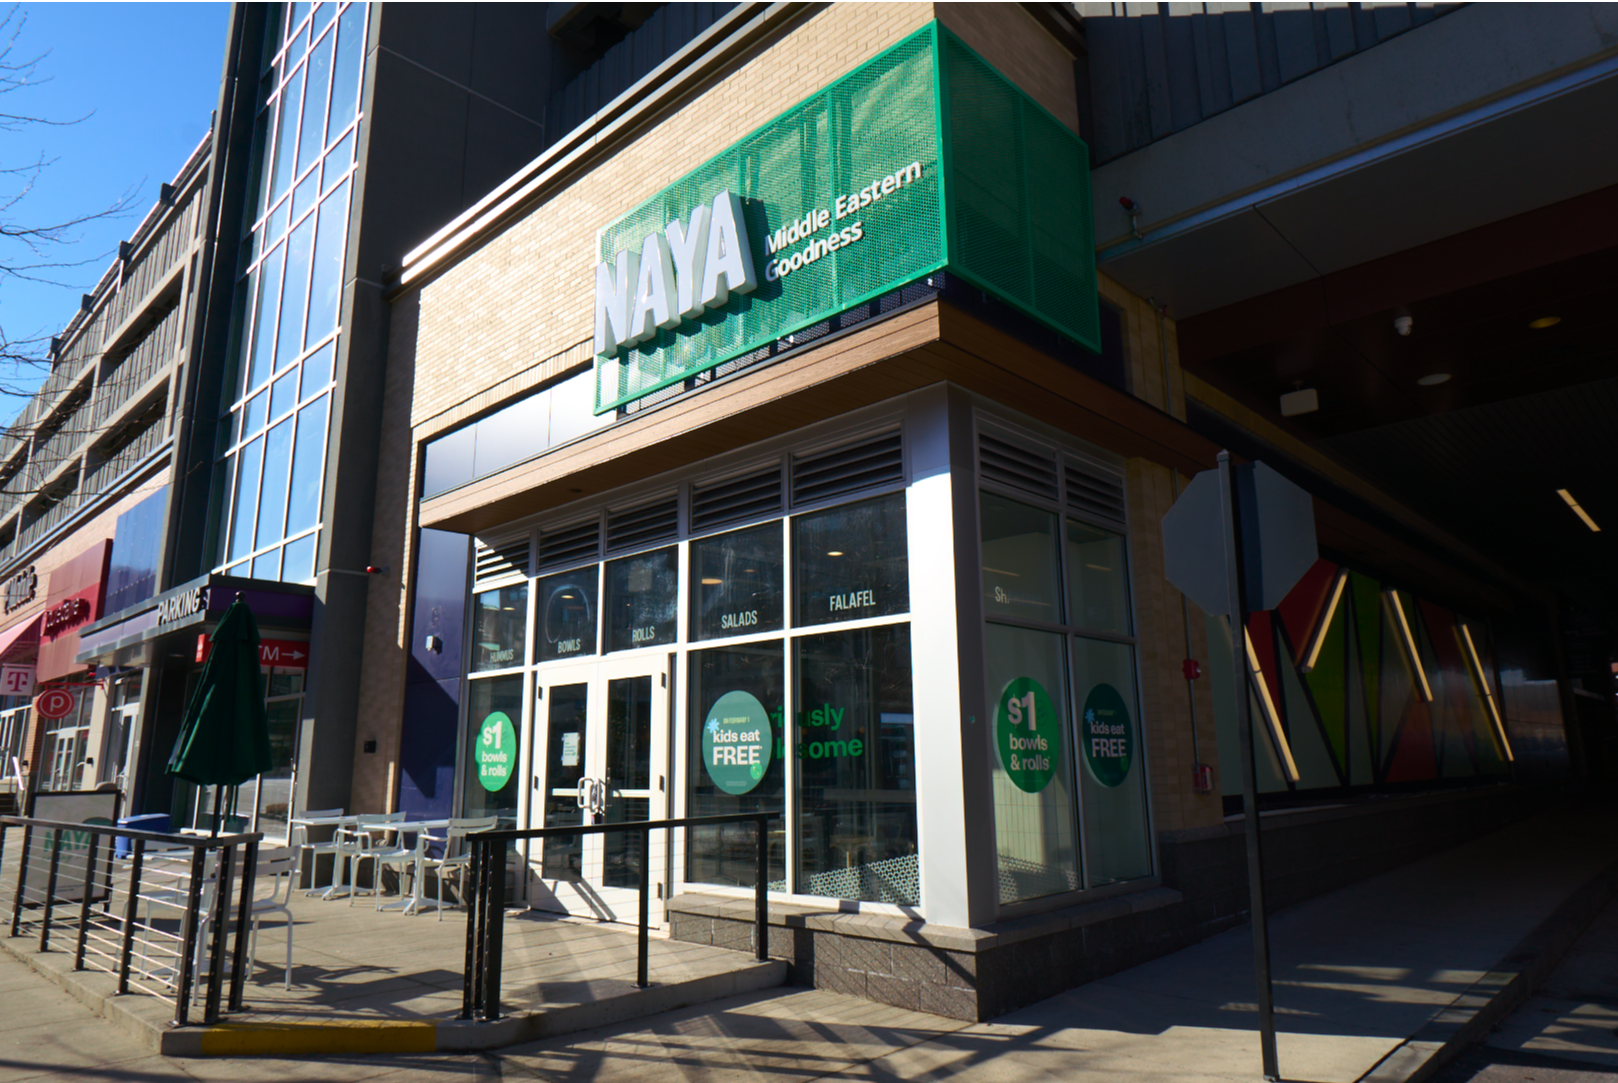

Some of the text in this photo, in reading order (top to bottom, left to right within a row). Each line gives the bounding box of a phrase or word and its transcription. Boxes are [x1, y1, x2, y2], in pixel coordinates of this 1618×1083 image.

[764, 161, 921, 257] Middle Eastern
[765, 220, 863, 282] Goodness
[594, 189, 757, 357] NAYA
[157, 587, 200, 626] PARKING
[830, 589, 876, 611] FALAFEL
[721, 610, 758, 629] SALADS
[632, 626, 655, 642] ROLLS
[490, 649, 514, 663] HUMMUS
[558, 639, 581, 654] BOWLS
[7, 671, 28, 692] T
[1007, 691, 1037, 731] $1
[483, 721, 502, 749] $1
[713, 729, 760, 743] kids eat
[1090, 720, 1125, 735] kids eat
[1009, 732, 1048, 751] bowls
[1091, 737, 1127, 758] FREE
[482, 751, 507, 763] bowls
[712, 745, 761, 766] FREE
[1010, 753, 1021, 771] &
[481, 764, 488, 776] &
